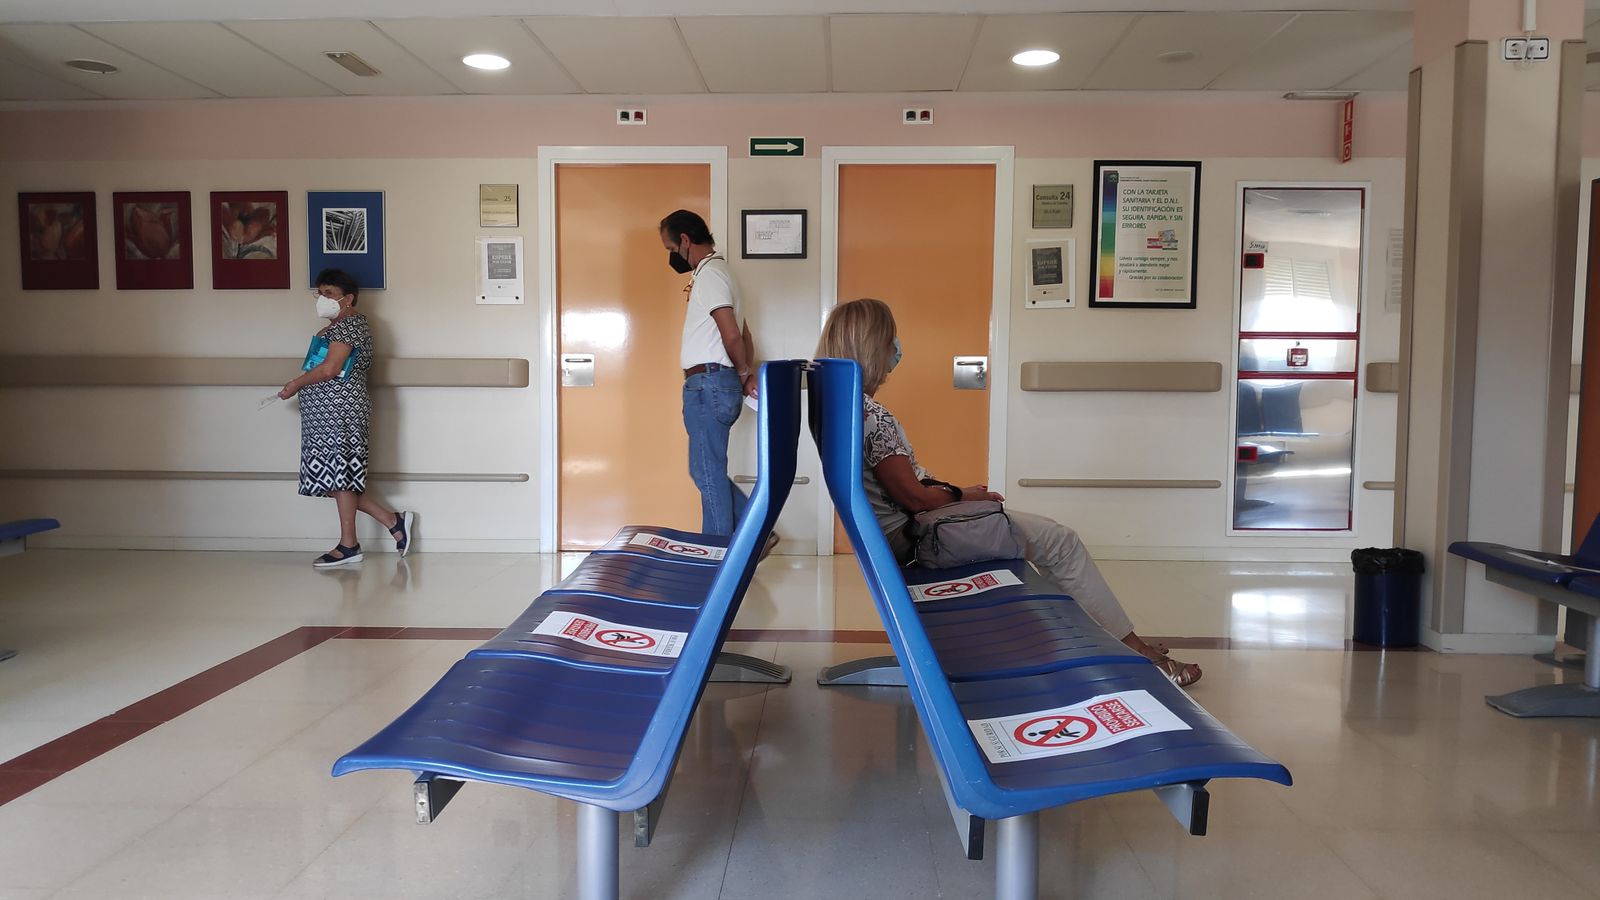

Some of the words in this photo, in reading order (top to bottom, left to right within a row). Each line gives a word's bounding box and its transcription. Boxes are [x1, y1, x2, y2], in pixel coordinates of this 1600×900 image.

[1059, 191, 1071, 201] 24
[1090, 704, 1122, 732] PROHIBIDO
[1105, 701, 1141, 727] SENTARSE
